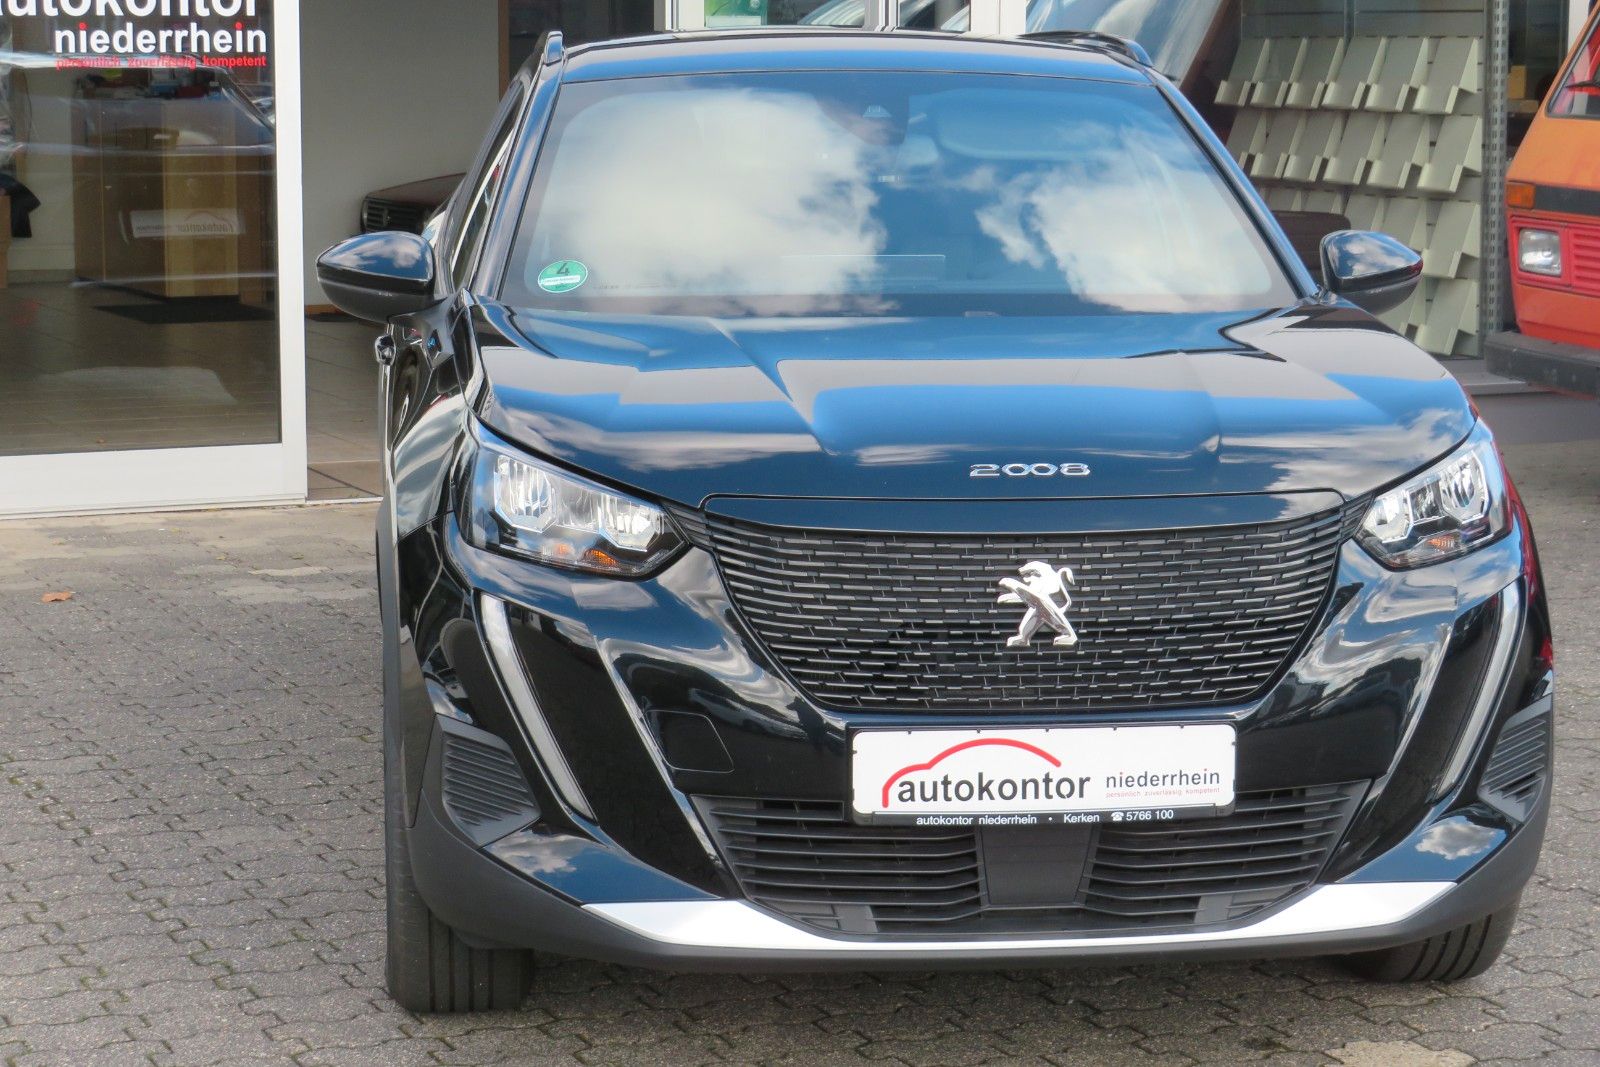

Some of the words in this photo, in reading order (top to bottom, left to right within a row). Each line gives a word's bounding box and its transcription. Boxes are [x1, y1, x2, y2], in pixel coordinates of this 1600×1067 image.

[55, 22, 267, 54] niederrhein
[203, 55, 267, 69] kompetent
[556, 262, 570, 276] 4
[969, 463, 1091, 477] 2008
[1106, 768, 1220, 788] niederrhein
[897, 771, 1091, 803] autokontor
[916, 815, 974, 826] autokontor
[978, 814, 1037, 825] niederrhein
[1063, 813, 1100, 824] Kerken
[1125, 811, 1152, 821] 5766
[1155, 809, 1174, 820] 100
